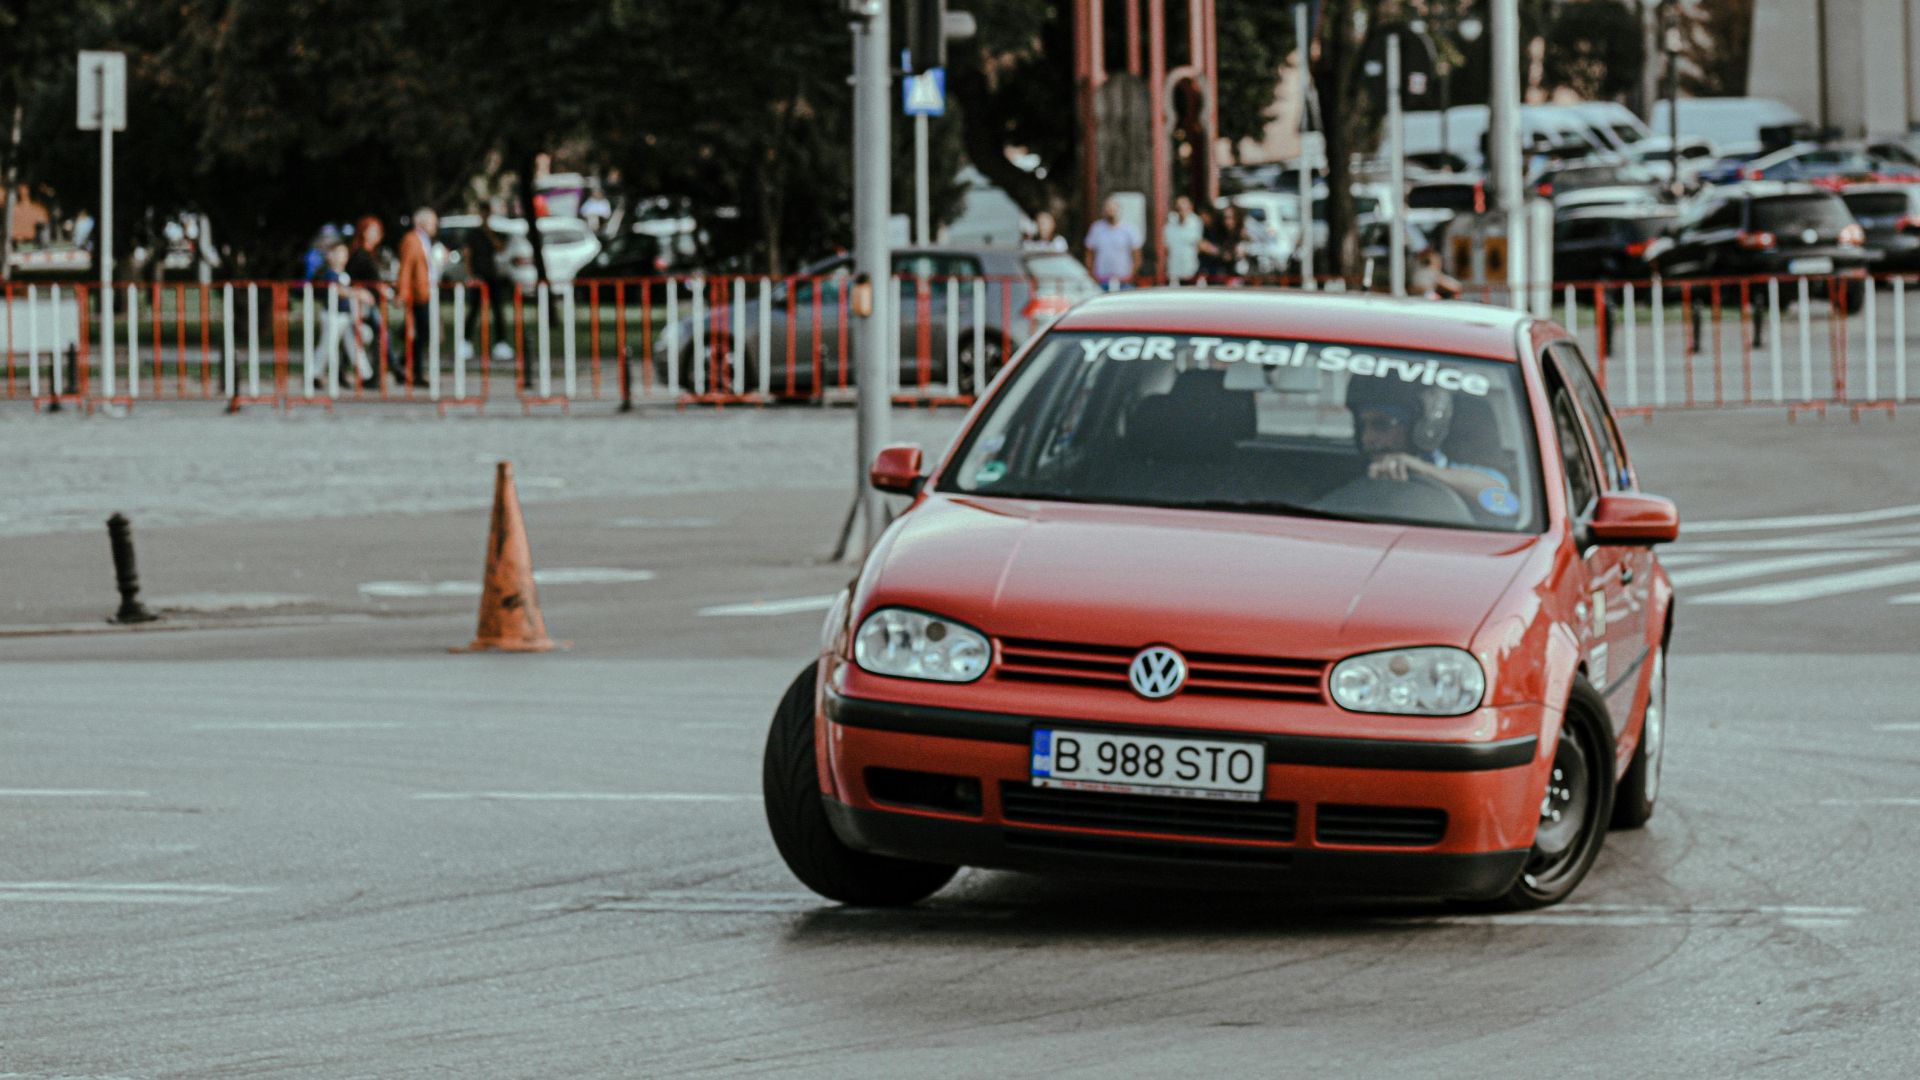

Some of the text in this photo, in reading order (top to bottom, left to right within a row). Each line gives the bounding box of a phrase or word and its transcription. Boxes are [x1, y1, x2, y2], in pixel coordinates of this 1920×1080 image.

[1080, 336, 1490, 396] YGR Total Service
[1129, 646, 1186, 698] VW
[1055, 738, 1254, 784] B 988 STO
